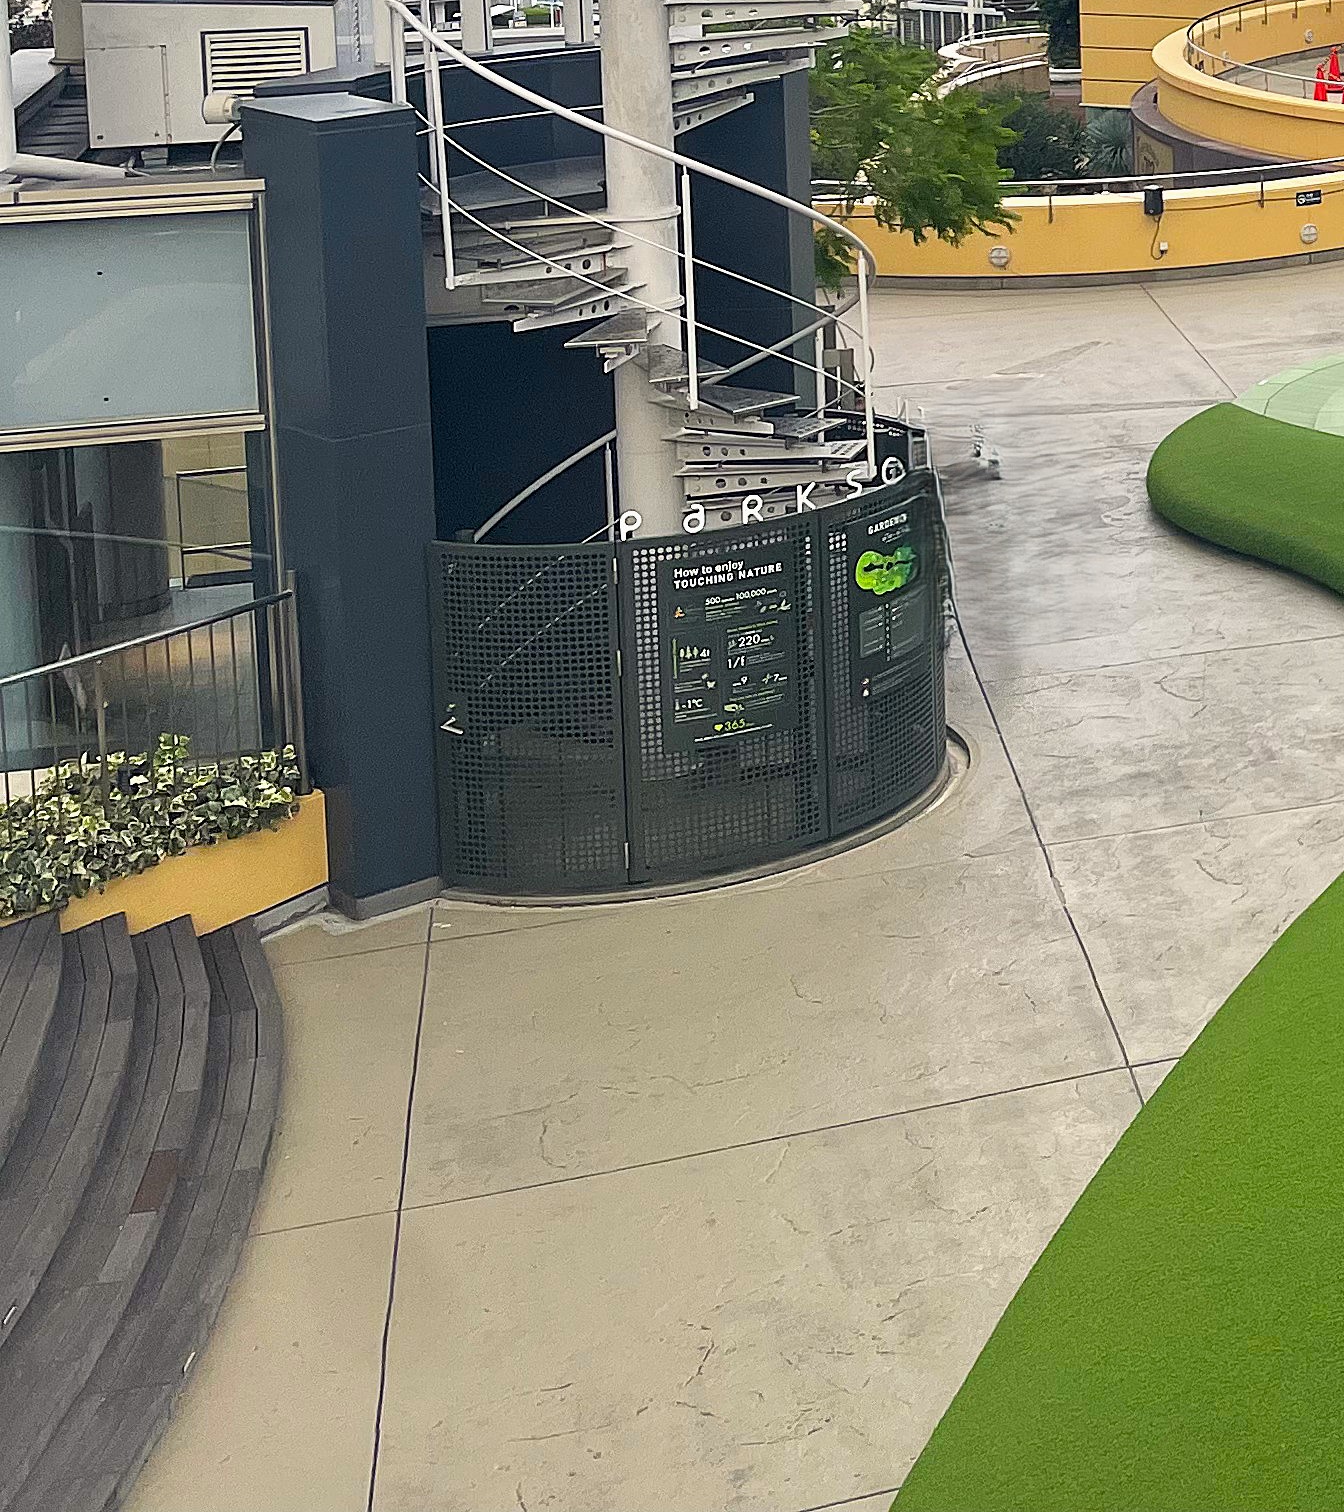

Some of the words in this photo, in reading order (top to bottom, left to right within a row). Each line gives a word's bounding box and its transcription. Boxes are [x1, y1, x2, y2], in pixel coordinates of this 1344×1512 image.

[673, 568, 700, 579] How
[701, 565, 712, 574] to
[714, 559, 744, 574] enjoy
[673, 572, 734, 590] TOUCHING
[738, 562, 783, 580] NATURE
[738, 634, 761, 648] 220
